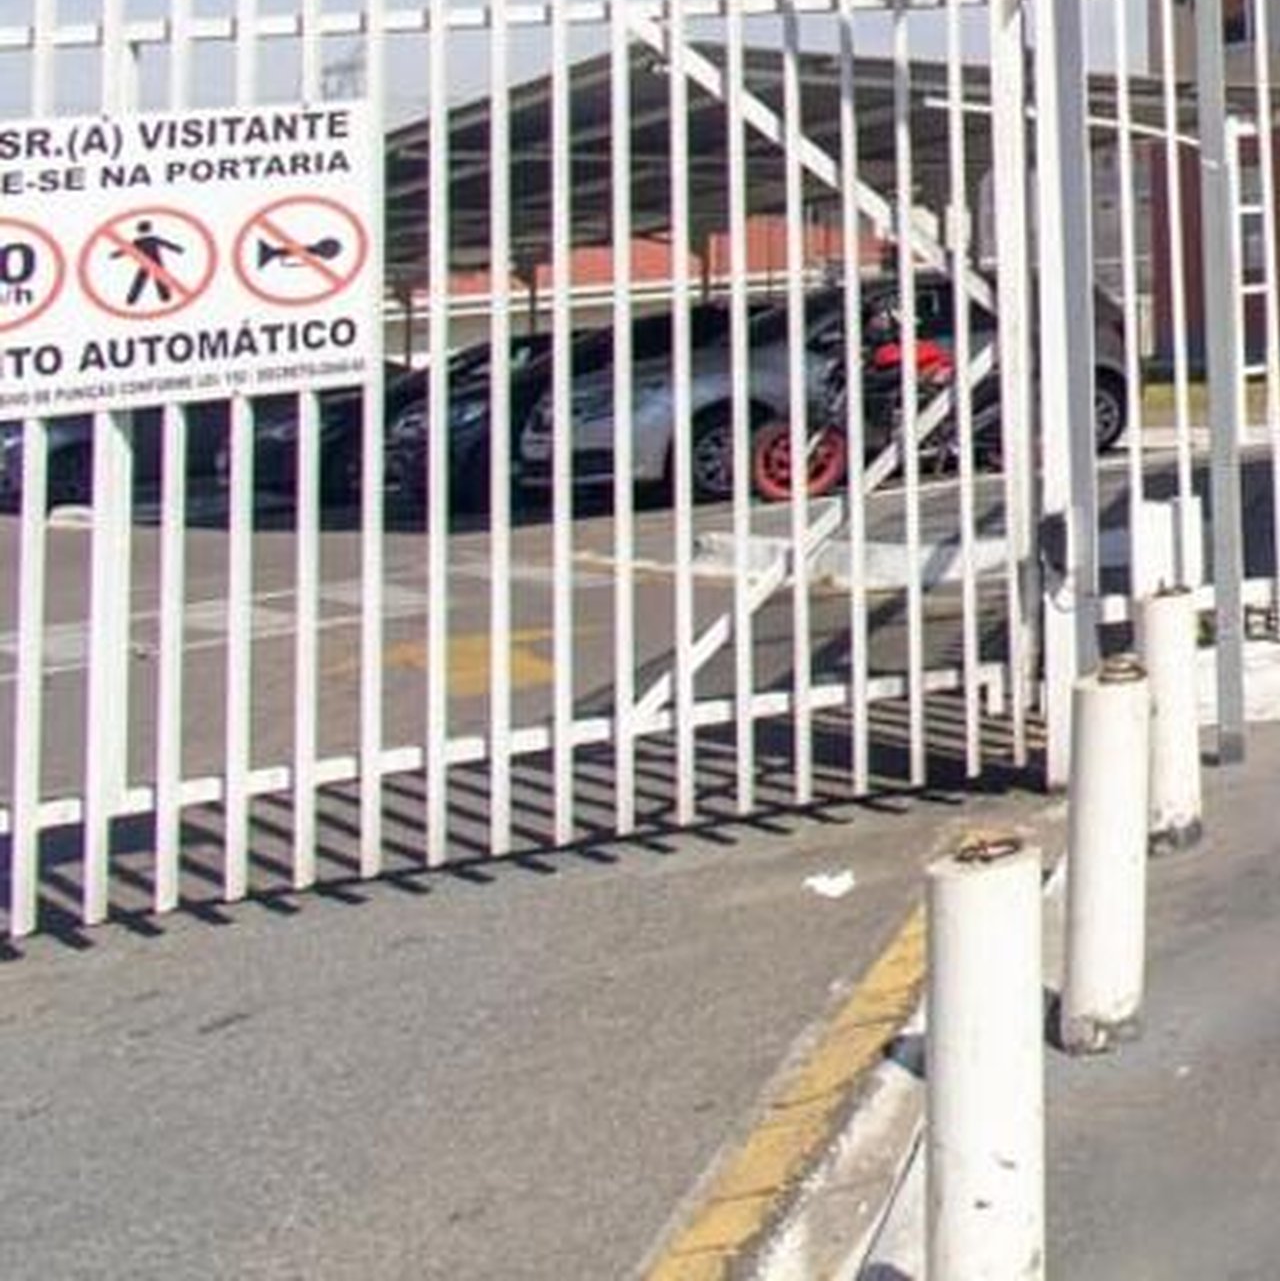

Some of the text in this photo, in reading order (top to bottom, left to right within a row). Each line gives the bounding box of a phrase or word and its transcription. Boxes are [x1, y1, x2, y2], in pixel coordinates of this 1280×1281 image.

[139, 109, 351, 150] VISITANTE
[100, 164, 151, 188] NA
[166, 149, 352, 184] PORTARIA
[79, 318, 357, 372] AUTOMÁTICO
